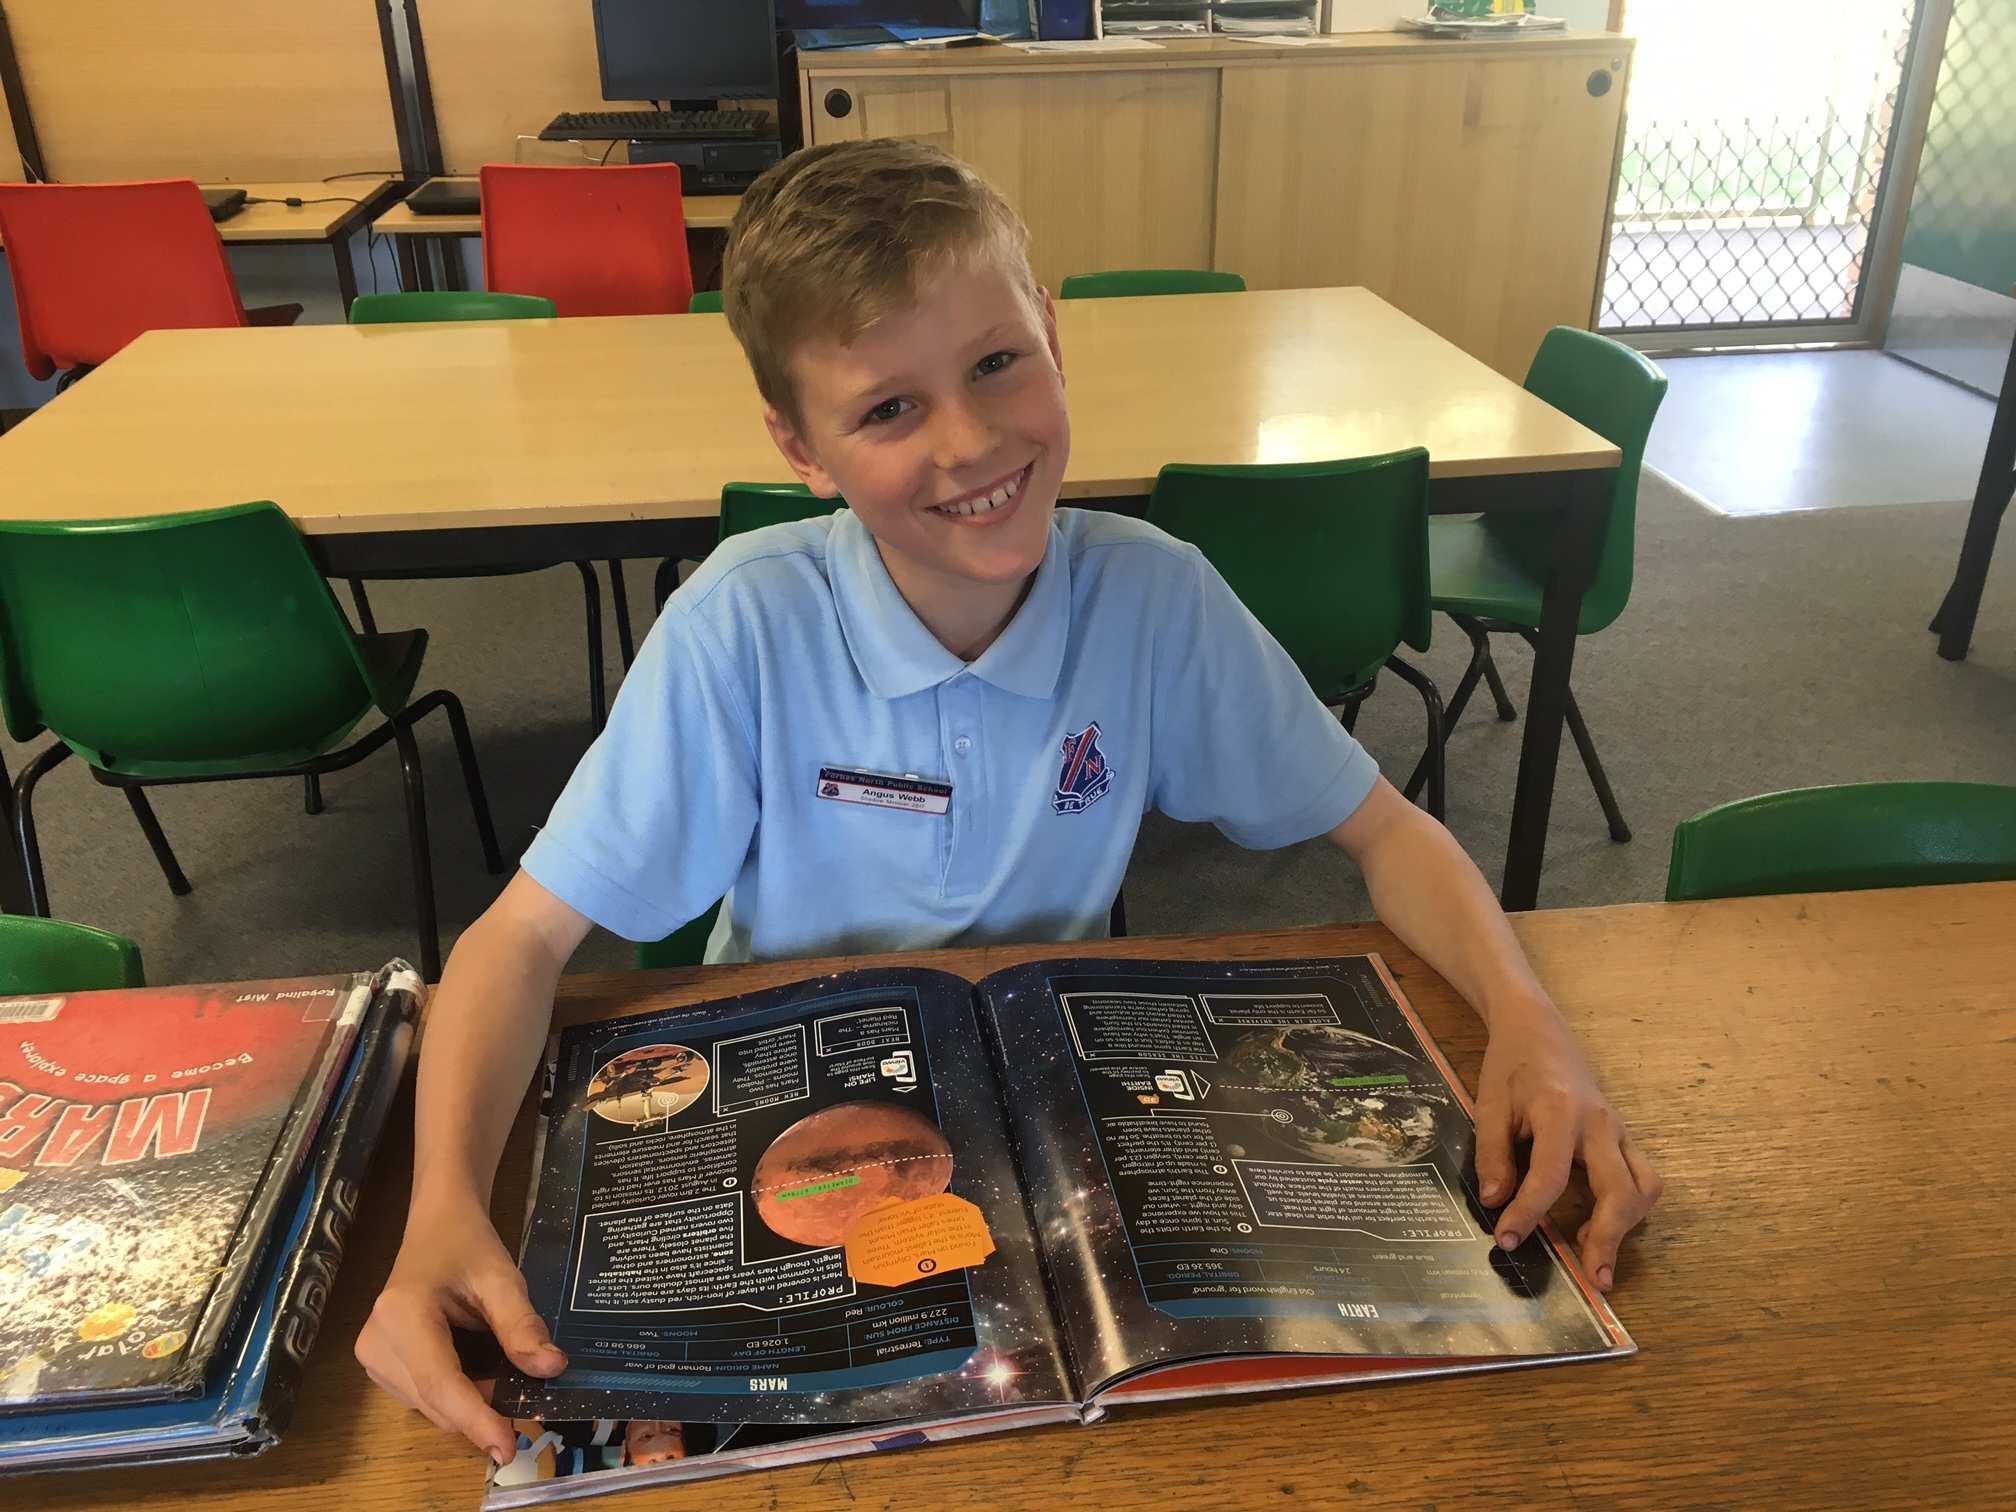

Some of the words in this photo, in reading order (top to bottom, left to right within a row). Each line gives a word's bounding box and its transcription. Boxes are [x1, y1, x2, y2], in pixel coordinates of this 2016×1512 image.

[1085, 755, 1101, 780] N
[863, 789, 895, 799] Angus
[898, 794, 926, 803] Webb
[275, 987, 336, 1001] Rosalind
[20, 1040, 66, 1078] explorer
[171, 1051, 253, 1080] Become
[74, 1073, 131, 1085] space
[143, 1073, 156, 1084] a
[848, 1072, 875, 1081] MARS!
[859, 1077, 876, 1085] LIFE
[0, 1082, 212, 1167] MAR
[715, 1201, 734, 1210] data
[654, 1210, 685, 1219] surface
[684, 1209, 734, 1222] Opportunity
[607, 1222, 647, 1233] gathering
[660, 1224, 689, 1234] named
[691, 1221, 716, 1229] rovers
[620, 1229, 658, 1239] Curiosity
[650, 1233, 681, 1243] circling
[683, 1228, 717, 1238] orbiters
[1402, 1229, 1463, 1237] PROFILE:
[626, 1238, 649, 1246] Mars,
[691, 1234, 718, 1245] planet
[672, 1247, 692, 1255] have
[694, 1241, 734, 1252] scientists
[609, 1253, 647, 1262] studying
[711, 1249, 734, 1257] zone,
[655, 1253, 709, 1265] astronomers
[703, 1258, 725, 1267] since
[812, 1253, 841, 1264] length,
[779, 1259, 810, 1271] though
[825, 1262, 842, 1271] lots
[599, 1269, 642, 1278] habitable
[688, 1265, 734, 1278] spacecraft
[732, 1268, 755, 1278] years
[757, 1266, 778, 1275] Mars
[777, 1268, 815, 1281] common
[822, 1271, 842, 1280] Mars
[635, 1275, 664, 1283] visited
[666, 1273, 686, 1281] have
[684, 1276, 714, 1285] almost
[755, 1275, 775, 1284] with
[652, 1280, 683, 1289] double
[739, 1279, 754, 1287] the
[777, 1277, 811, 1290] covered
[630, 1290, 658, 1298] nearly
[676, 1286, 697, 1295] days
[736, 1286, 758, 1295] layer
[779, 1284, 843, 1303] PROFILE:
[1266, 1285, 1297, 1295] English
[640, 1295, 666, 1305] dusty
[668, 1296, 682, 1304] red
[845, 1308, 863, 1318] Red
[921, 1308, 948, 1319] 227.9
[1337, 1303, 1379, 1318] EARTH
[872, 1319, 887, 1329] km
[888, 1313, 919, 1326] million
[916, 1316, 959, 1329] DISTANCE
[639, 1330, 659, 1338] Two
[887, 1324, 913, 1335] FROM
[746, 1341, 760, 1349] ED
[762, 1338, 789, 1348] 1.026
[924, 1335, 950, 1345] TYPE:
[611, 1342, 646, 1350] 686.98
[768, 1345, 806, 1355] LENGTH
[876, 1340, 923, 1356] Terrestrial
[657, 1362, 675, 1371] god
[677, 1364, 712, 1372] Roman
[750, 1378, 787, 1391] MARS
